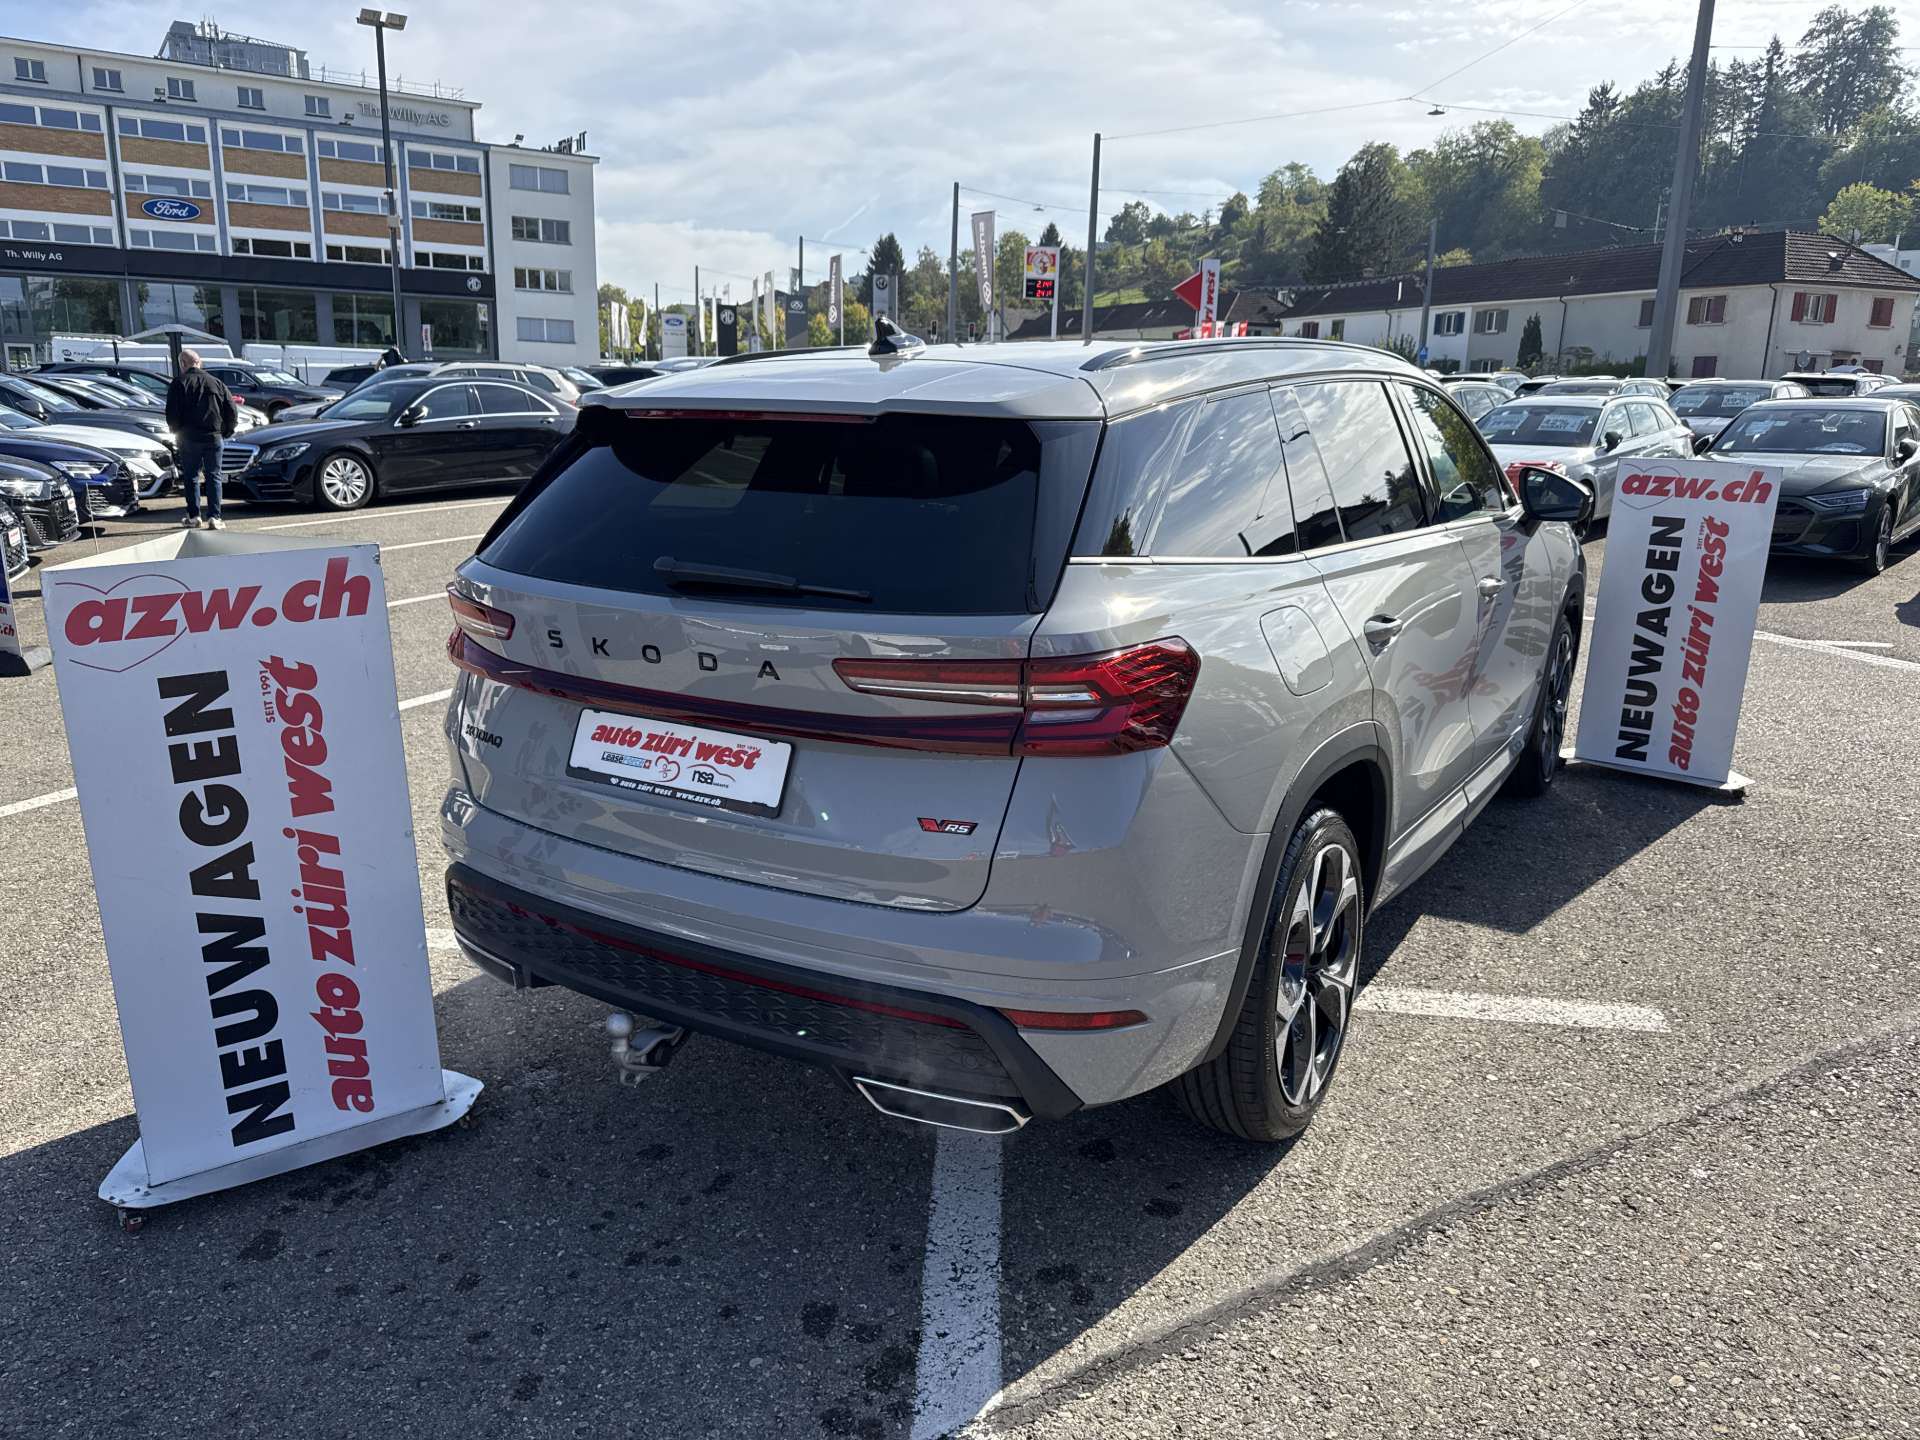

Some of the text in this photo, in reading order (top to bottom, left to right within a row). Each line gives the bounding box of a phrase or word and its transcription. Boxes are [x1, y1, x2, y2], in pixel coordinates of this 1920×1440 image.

[389, 109, 424, 127] Willy
[427, 112, 451, 127] AG
[153, 200, 190, 218] Ford
[5, 249, 63, 262] Th. Willy AG
[1621, 470, 1773, 504] azw.ch
[64, 556, 372, 647] azw.ch
[547, 629, 781, 681] SKODA
[1615, 515, 1687, 762] NEUWAGEN
[1668, 515, 1730, 771] auto züri west
[259, 669, 276, 724] SEIT 1991
[590, 724, 764, 770] auto züri west
[619, 779, 638, 790] auto
[654, 785, 673, 797] west
[691, 769, 714, 785] nsa
[157, 669, 296, 1148] NEUWAGEN
[258, 655, 376, 1114] auto züri west
